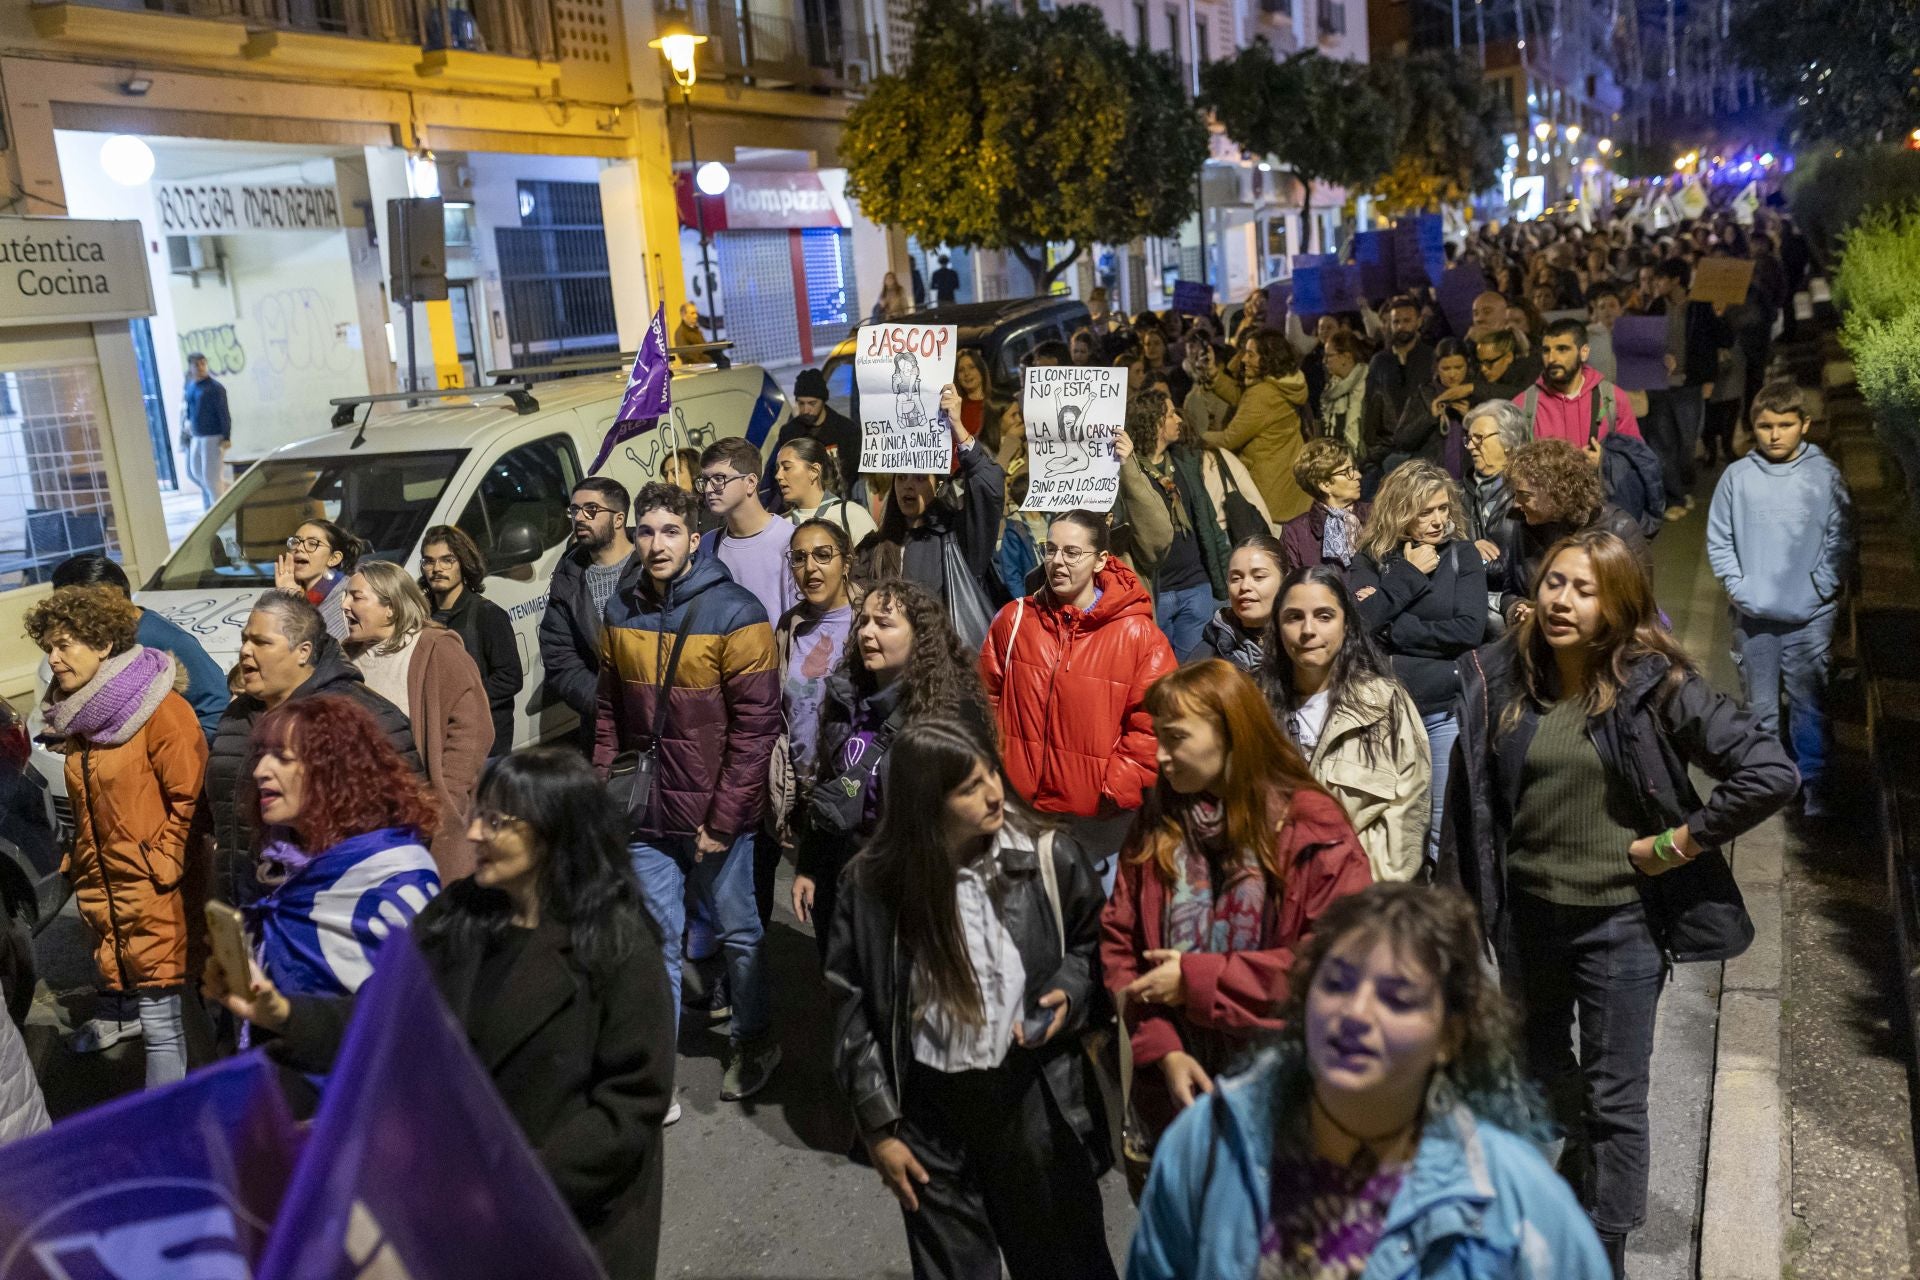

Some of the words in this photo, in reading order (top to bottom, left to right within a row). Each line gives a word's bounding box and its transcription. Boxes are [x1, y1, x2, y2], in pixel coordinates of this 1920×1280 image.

[160, 186, 237, 230] BODEGA
[731, 182, 832, 217] Rompizza
[17, 268, 110, 296] Cocina
[867, 327, 949, 361] ¿ASCO?
[1030, 369, 1043, 384] EL
[1044, 368, 1110, 382] CONFLICTO
[1030, 383, 1051, 399] NO
[1063, 379, 1094, 397] ESTÁ
[1100, 383, 1120, 398] EN
[865, 419, 894, 436] ESTA
[928, 417, 946, 434] ES
[1033, 421, 1051, 438] LA
[865, 437, 878, 451] LA
[881, 434, 908, 452] ÚNICA
[910, 431, 943, 448] SANGRE
[1034, 440, 1056, 457] QUE
[1088, 440, 1103, 458] SE
[862, 452, 879, 468] QUE
[881, 449, 912, 468] DEBERÍA
[912, 449, 950, 469] VERTERSE
[1031, 479, 1056, 494] SINO
[1057, 478, 1075, 493] EN
[1076, 476, 1095, 491] LOS
[1095, 476, 1117, 492] OJOS
[1025, 495, 1046, 508] QUE
[1048, 493, 1084, 507] MIRAN
